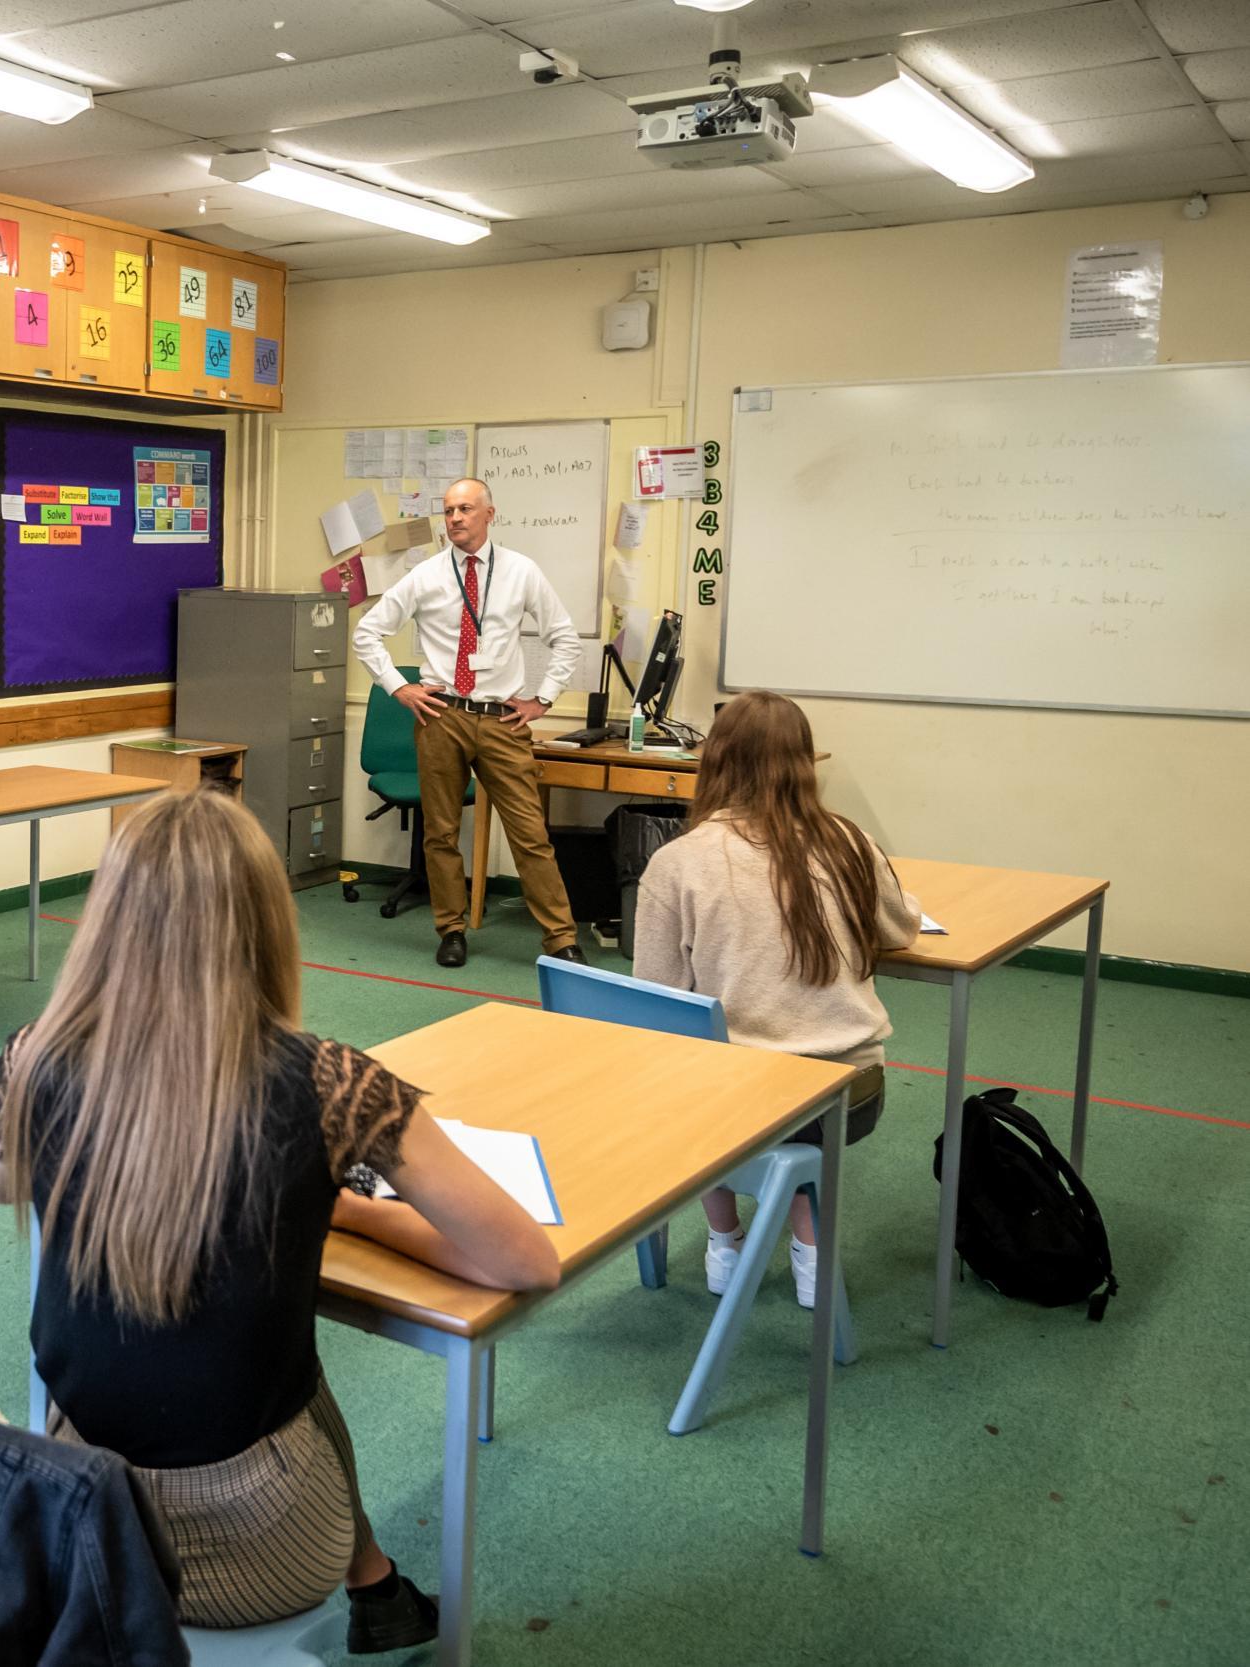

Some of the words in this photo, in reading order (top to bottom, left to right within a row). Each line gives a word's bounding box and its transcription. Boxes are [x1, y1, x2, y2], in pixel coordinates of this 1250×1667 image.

[64, 250, 76, 276] 9
[118, 261, 138, 294] 25
[184, 276, 201, 304] 49
[27, 303, 38, 326] 4
[234, 290, 253, 318] 81
[86, 317, 107, 347] 16
[157, 332, 176, 362] 36
[208, 339, 228, 367] 64
[255, 349, 276, 374] 100
[25, 489, 56, 499] Substitute
[61, 490, 87, 501] Factorise
[91, 492, 106, 501] Show
[107, 493, 119, 502] that
[47, 509, 67, 520] Solve
[76, 513, 93, 521] Word
[94, 513, 108, 521] Wall
[23, 530, 47, 539] Expand
[53, 530, 78, 540] Explain
